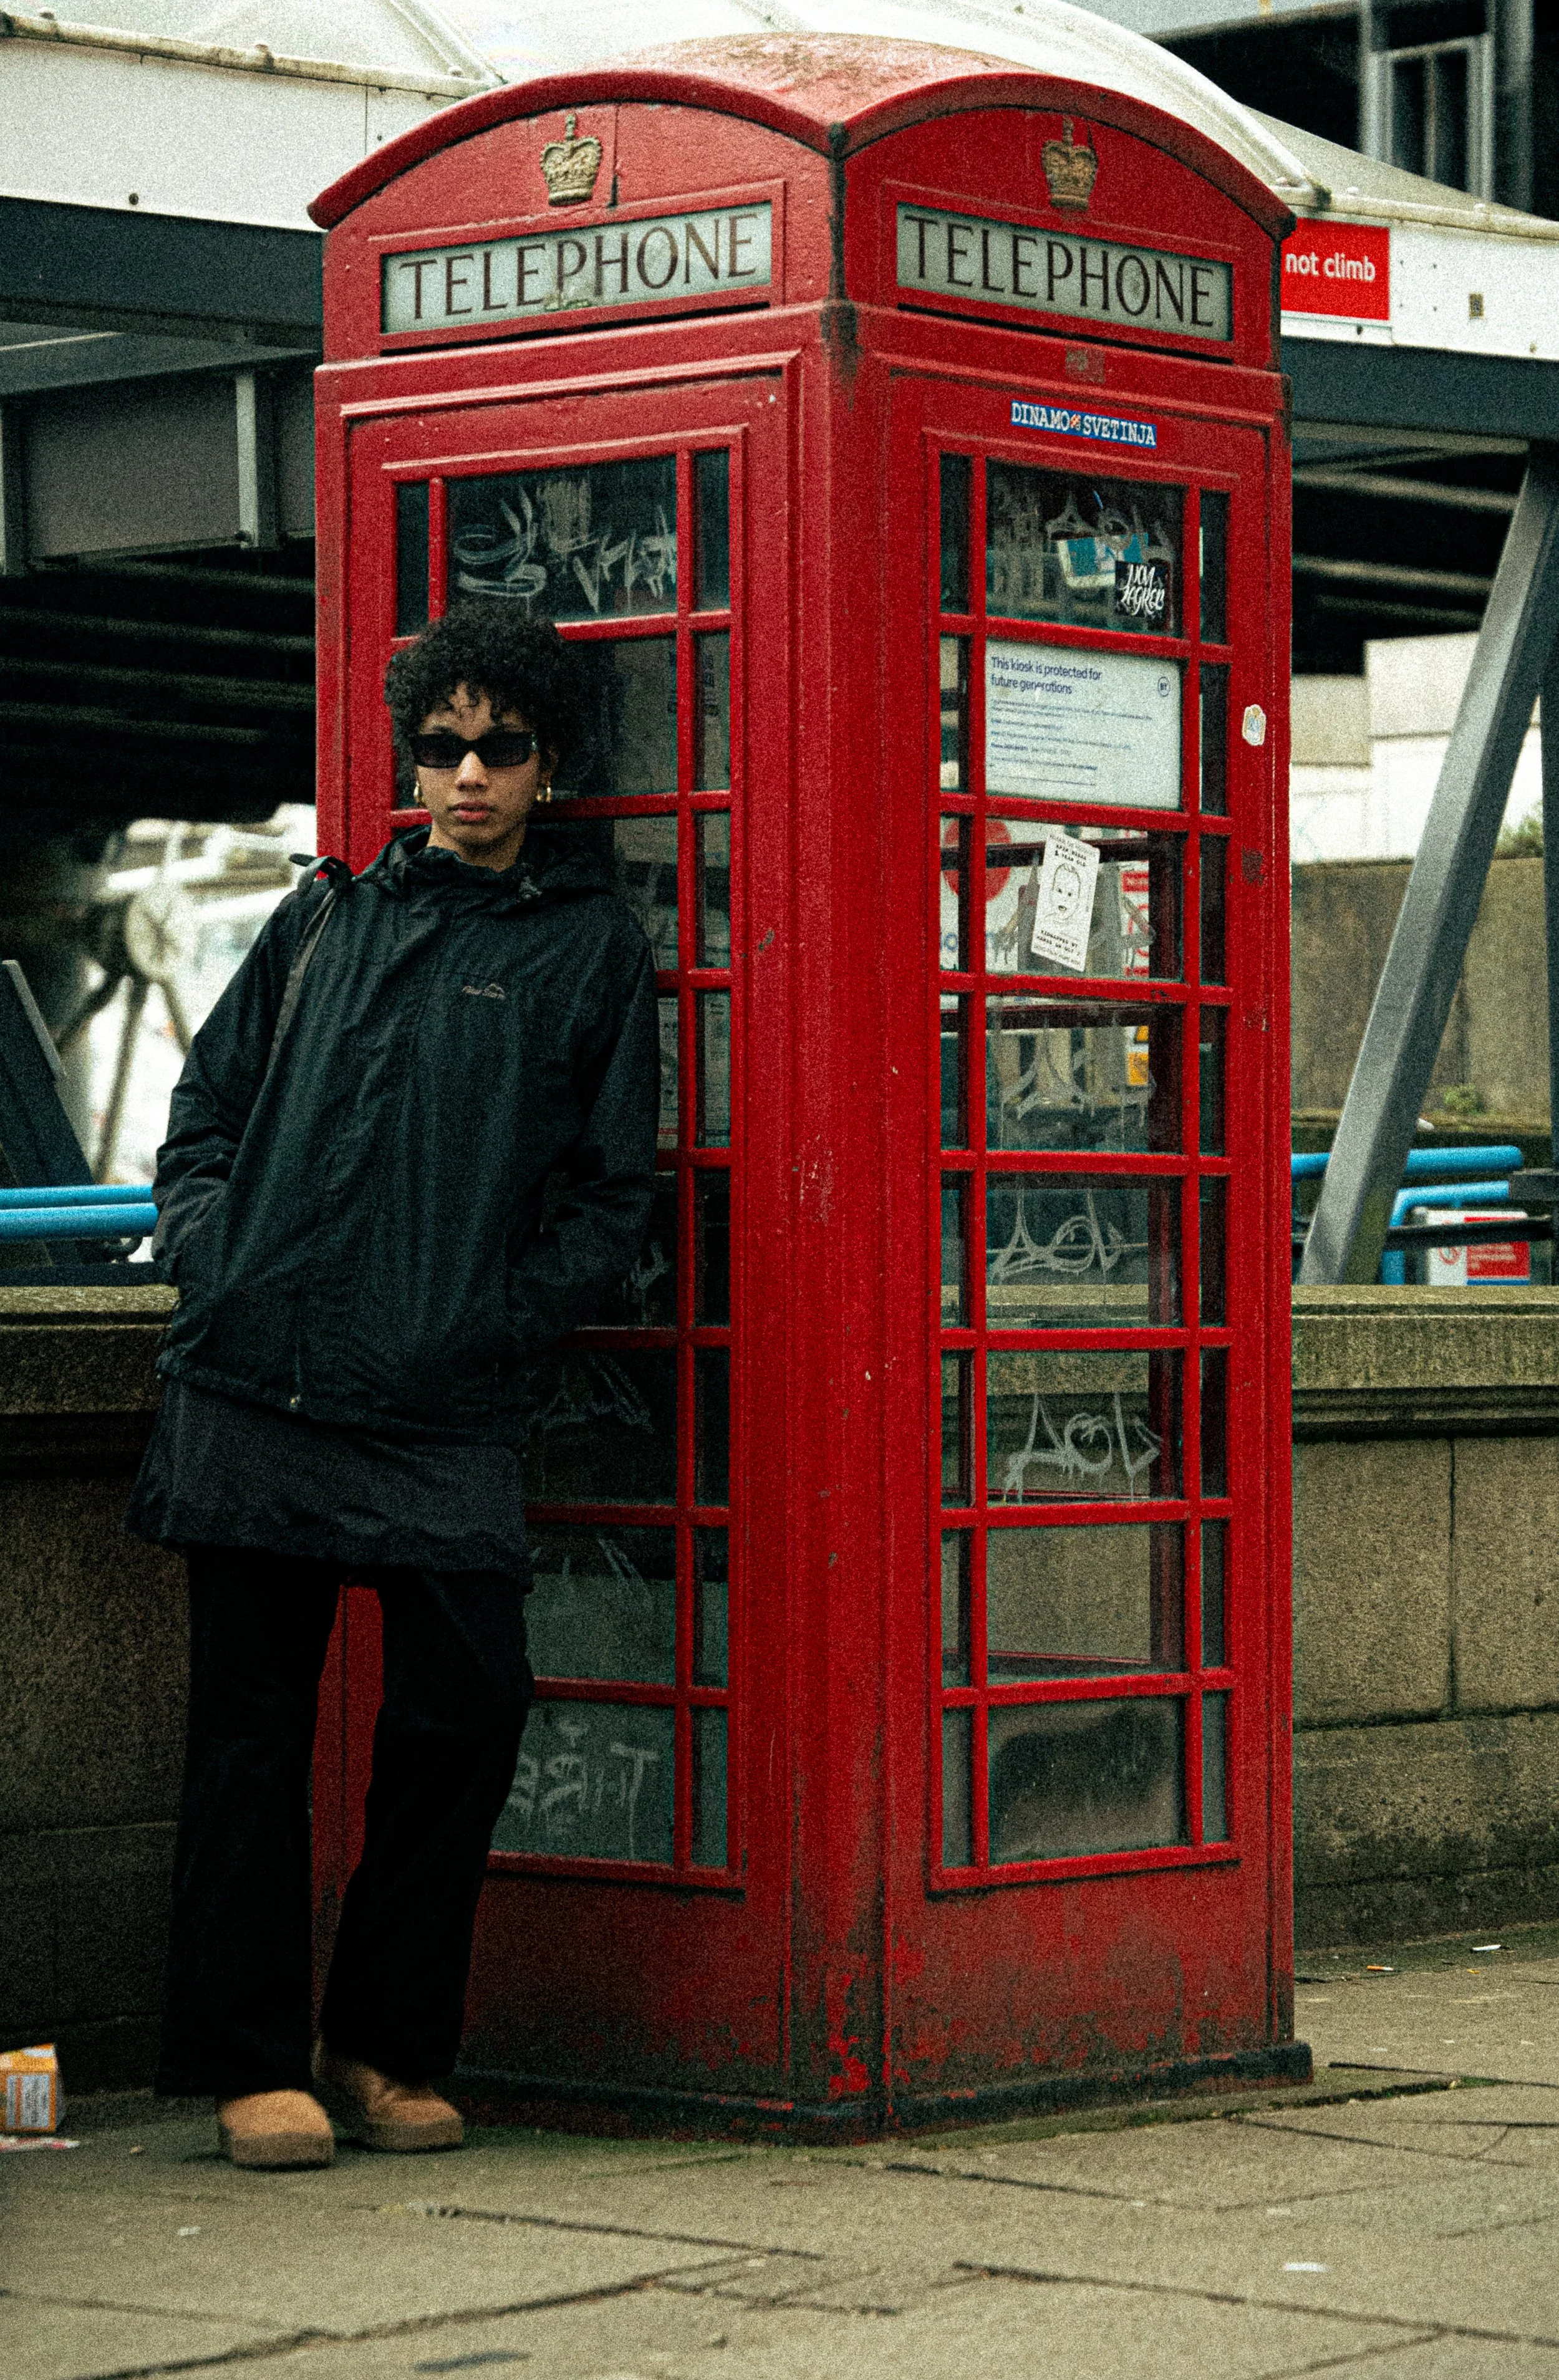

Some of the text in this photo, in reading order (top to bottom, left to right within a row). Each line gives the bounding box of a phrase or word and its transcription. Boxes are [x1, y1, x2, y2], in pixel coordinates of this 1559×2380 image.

[400, 212, 759, 319] TELEPHONE
[904, 214, 1214, 327] TELEPHONE
[1285, 251, 1376, 282] not climb
[1011, 402, 1157, 446] DINAMO SVETINJA
[990, 673, 1073, 695] future generations
[991, 657, 1102, 680] This kiosk is protected for
